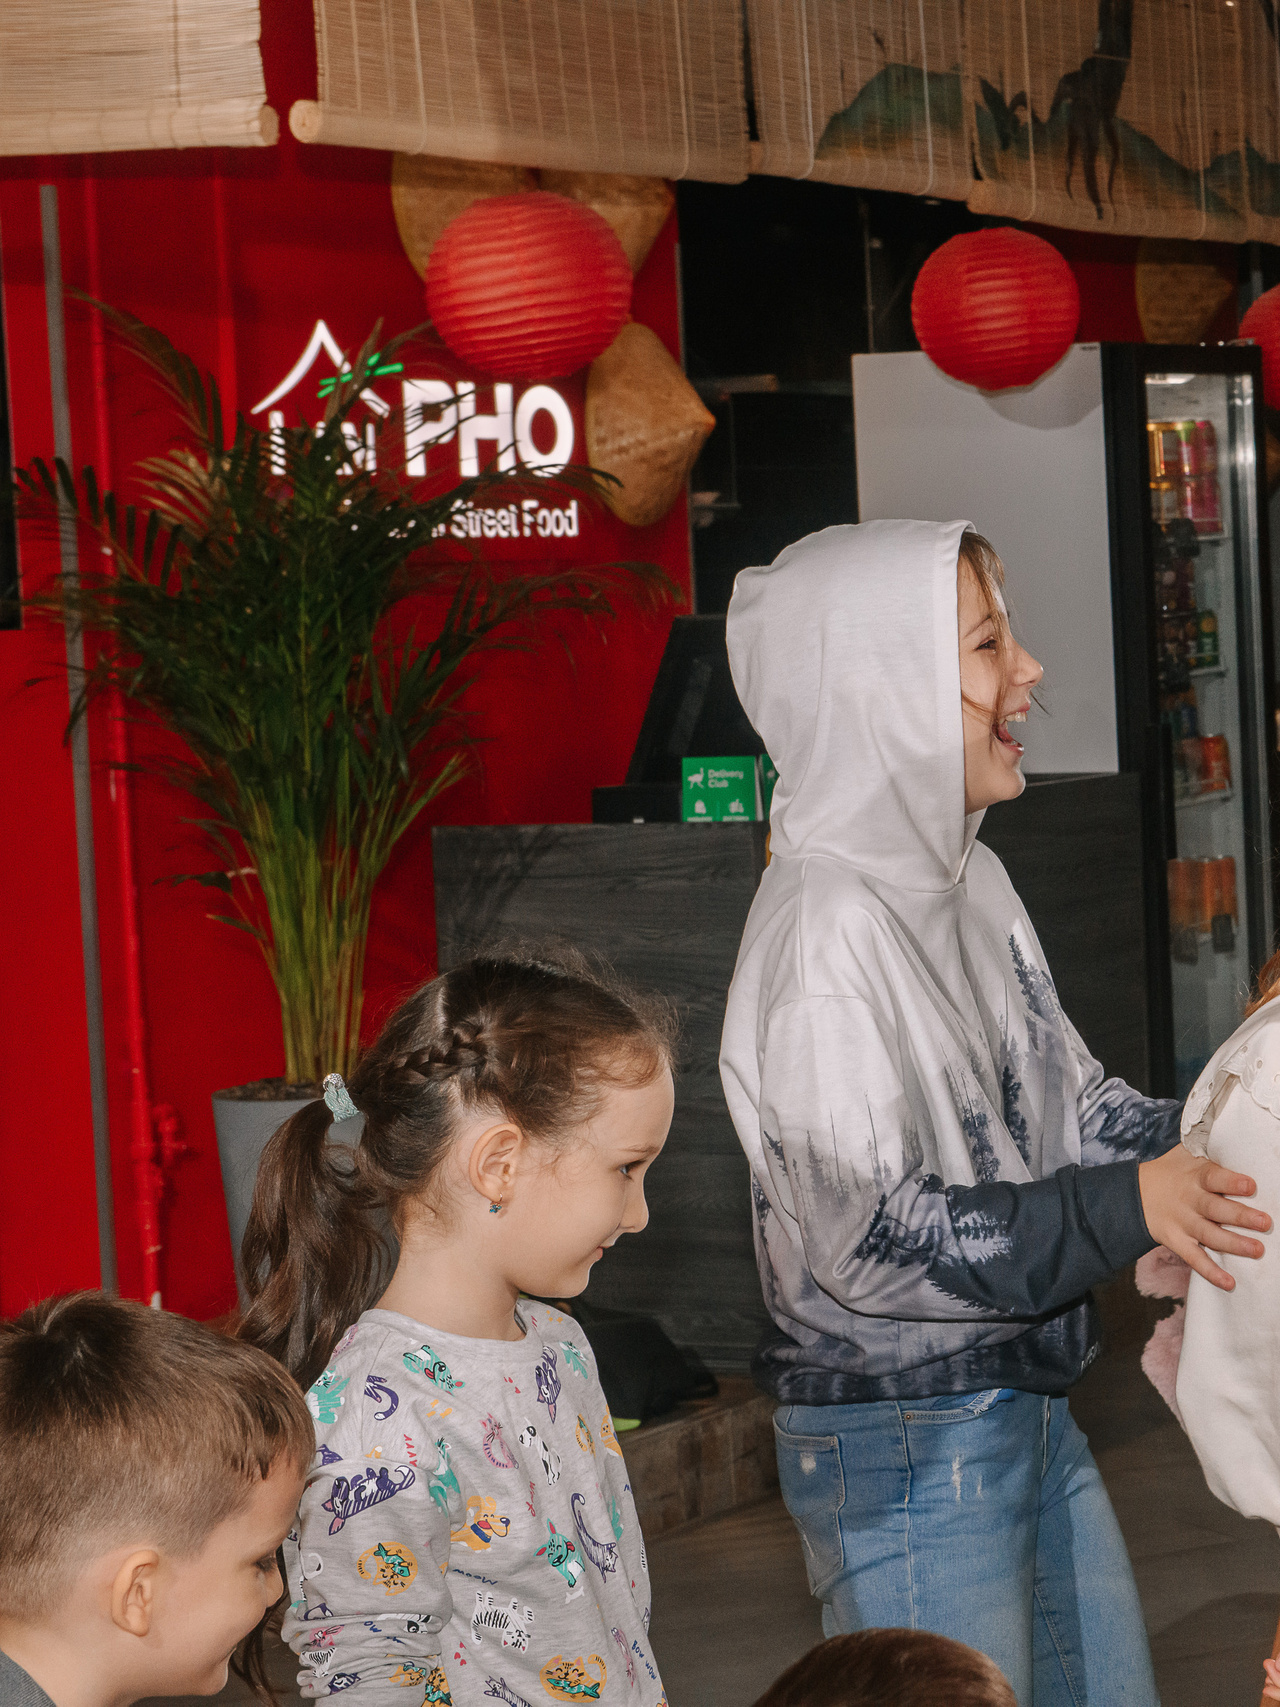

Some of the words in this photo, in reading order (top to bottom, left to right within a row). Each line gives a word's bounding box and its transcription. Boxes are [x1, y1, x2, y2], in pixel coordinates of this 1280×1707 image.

[402, 379, 575, 477] PHO
[450, 499, 519, 538] Street
[521, 499, 579, 538] Food
